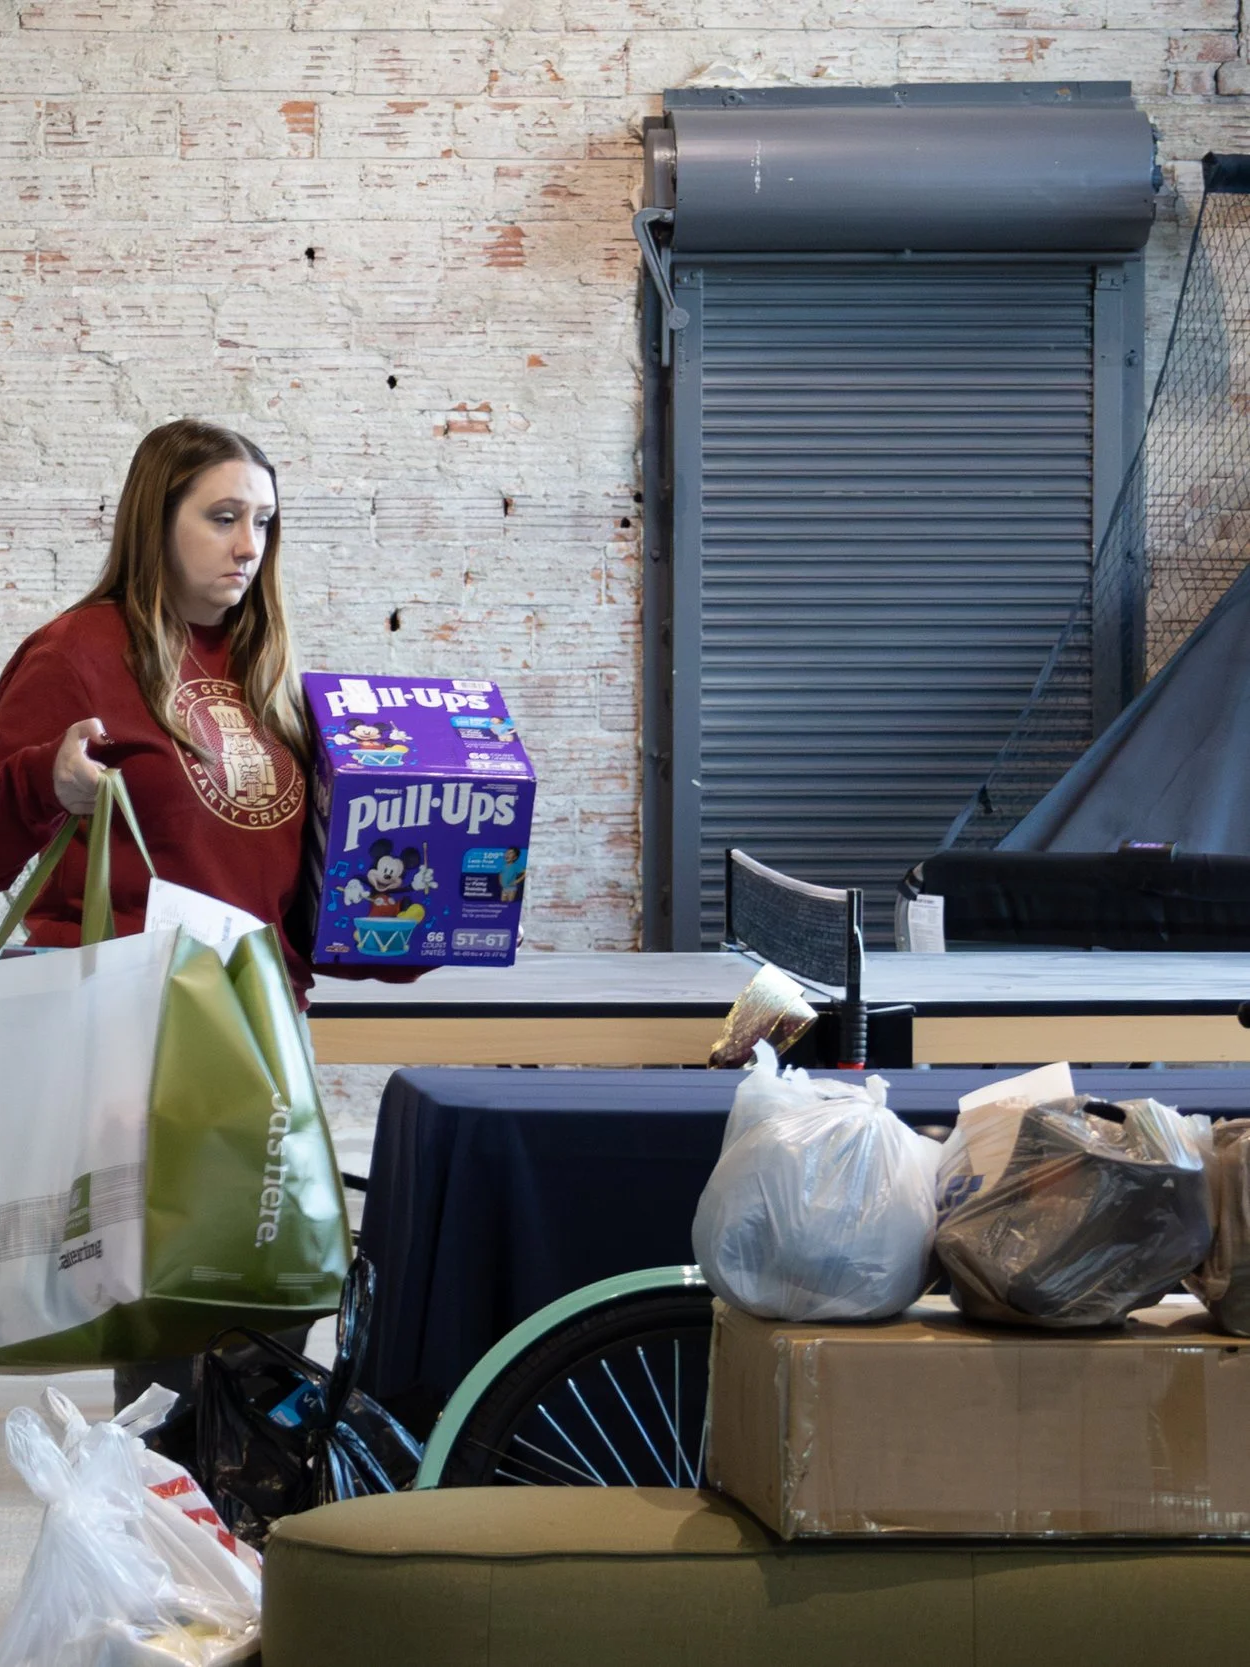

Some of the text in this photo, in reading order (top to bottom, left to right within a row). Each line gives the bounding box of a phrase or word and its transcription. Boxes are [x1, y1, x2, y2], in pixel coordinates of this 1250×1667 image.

[200, 684, 235, 697] GET
[190, 763, 241, 820] PARTY
[426, 931, 445, 942] 66
[254, 1163, 290, 1248] here.
